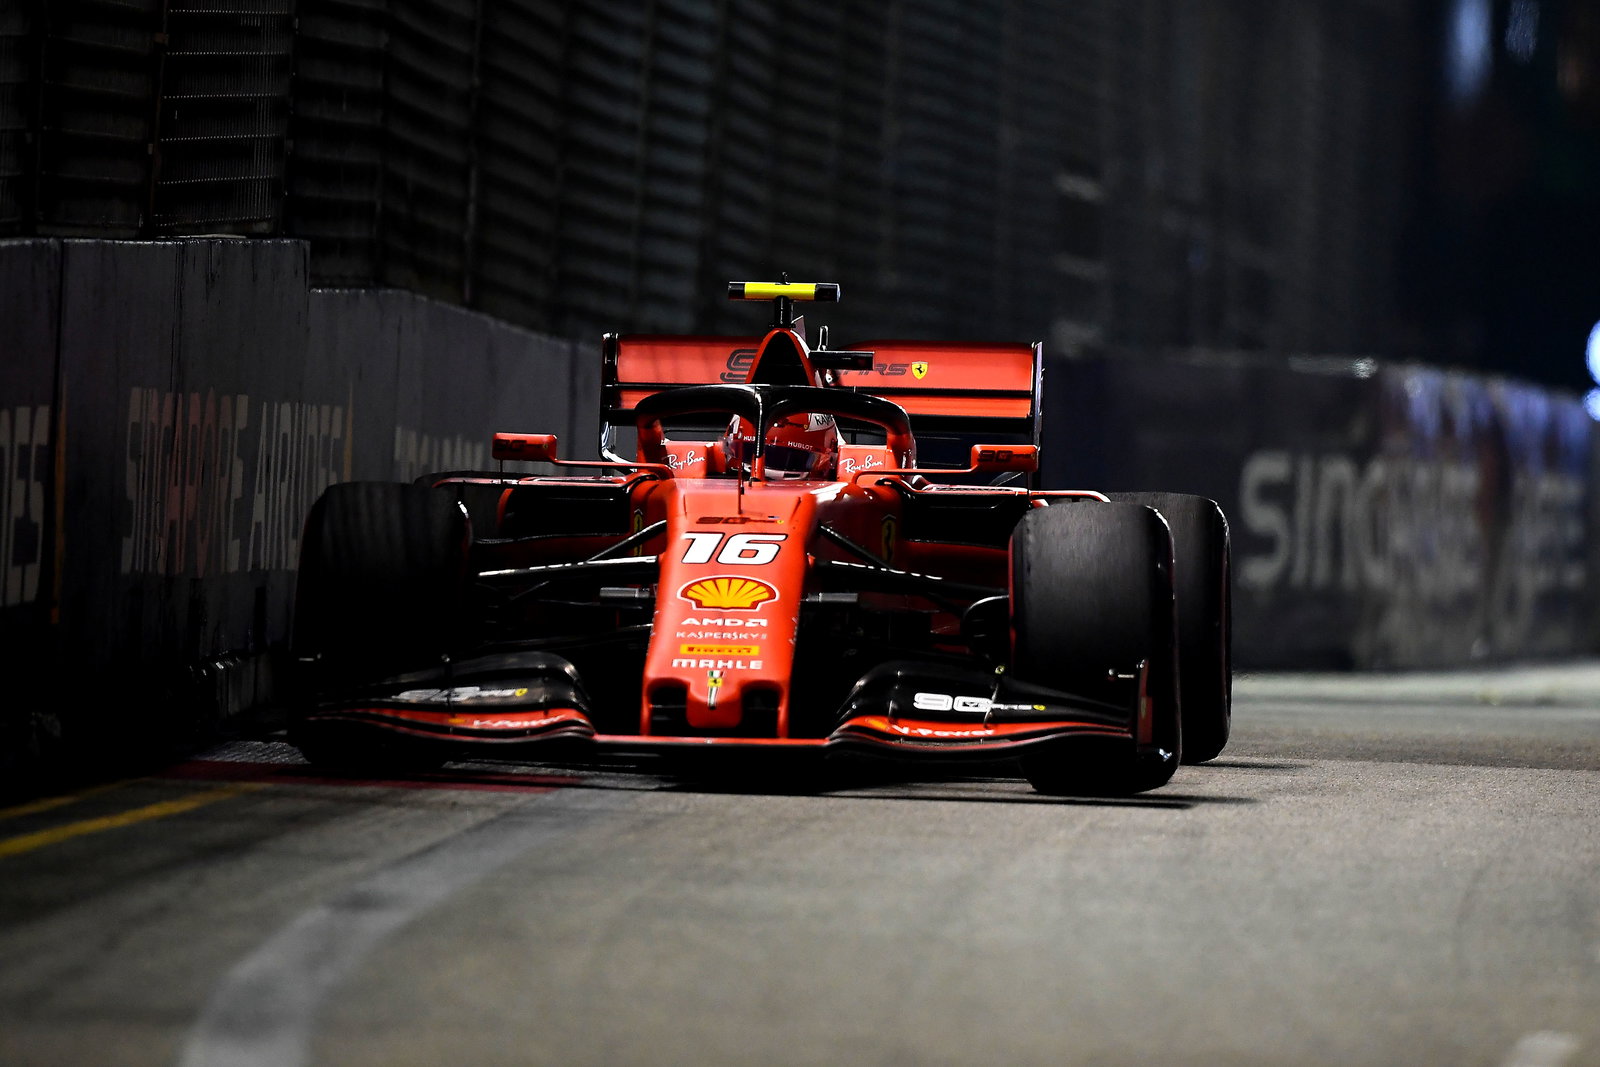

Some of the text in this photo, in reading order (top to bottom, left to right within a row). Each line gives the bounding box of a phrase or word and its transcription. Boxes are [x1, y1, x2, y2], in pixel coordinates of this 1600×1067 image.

[787, 441, 813, 450] HUBLOT
[121, 386, 248, 578] SINGAPORE
[680, 531, 789, 566] 16
[681, 617, 744, 627] AMD
[676, 631, 759, 640] KASPERSKY
[672, 658, 763, 670] MAHLE
